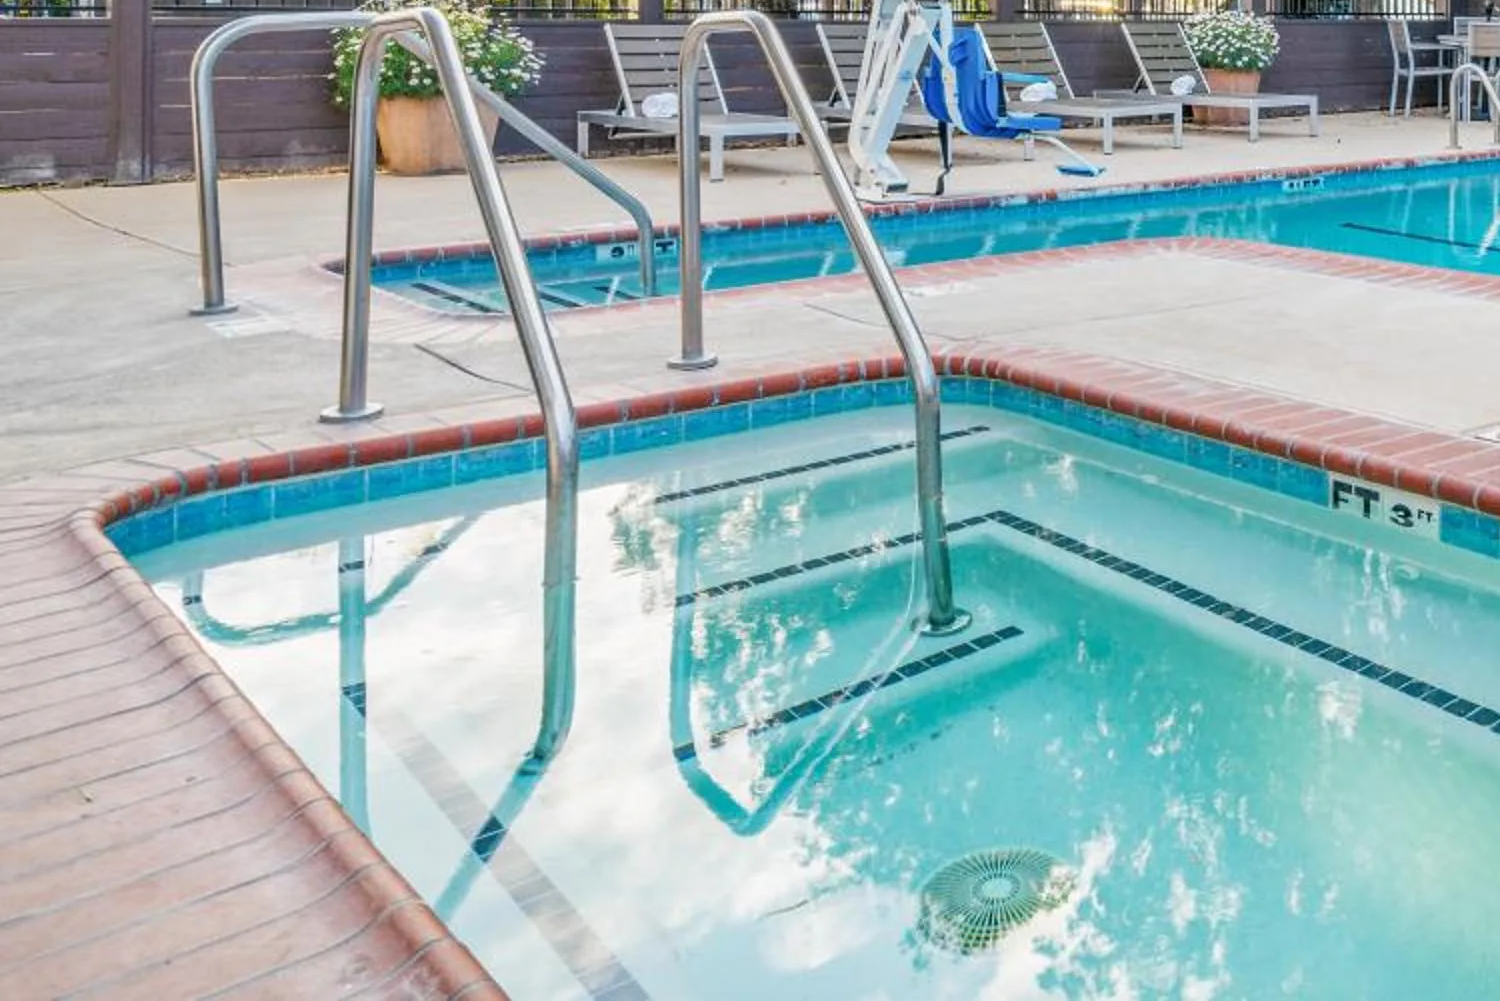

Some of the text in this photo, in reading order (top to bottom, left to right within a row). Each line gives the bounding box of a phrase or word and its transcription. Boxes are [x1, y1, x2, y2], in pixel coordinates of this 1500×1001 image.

[1332, 479, 1433, 528] FT 3 FT
